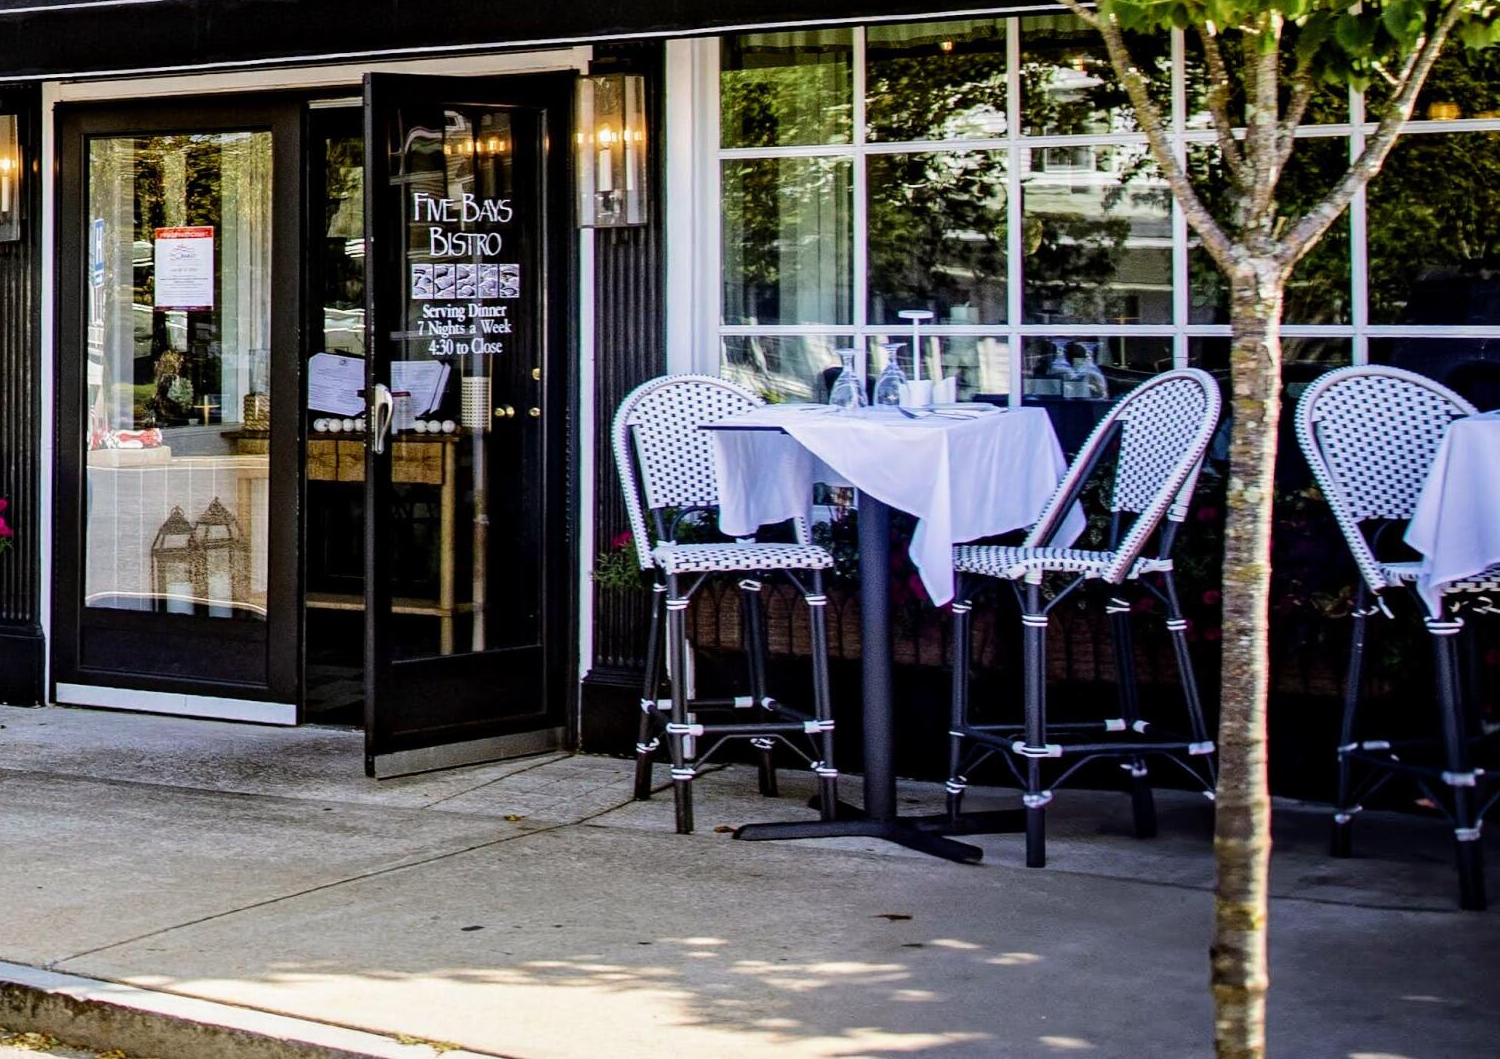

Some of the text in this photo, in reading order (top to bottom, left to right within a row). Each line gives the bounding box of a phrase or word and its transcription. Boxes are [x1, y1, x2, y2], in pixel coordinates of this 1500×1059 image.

[414, 192, 514, 223] FIVE BAYS
[429, 226, 502, 257] BISTRO
[422, 303, 507, 322] Serving Dinner
[417, 318, 512, 339] 7 Nights a Week
[428, 337, 504, 356] 4:30 to Close
